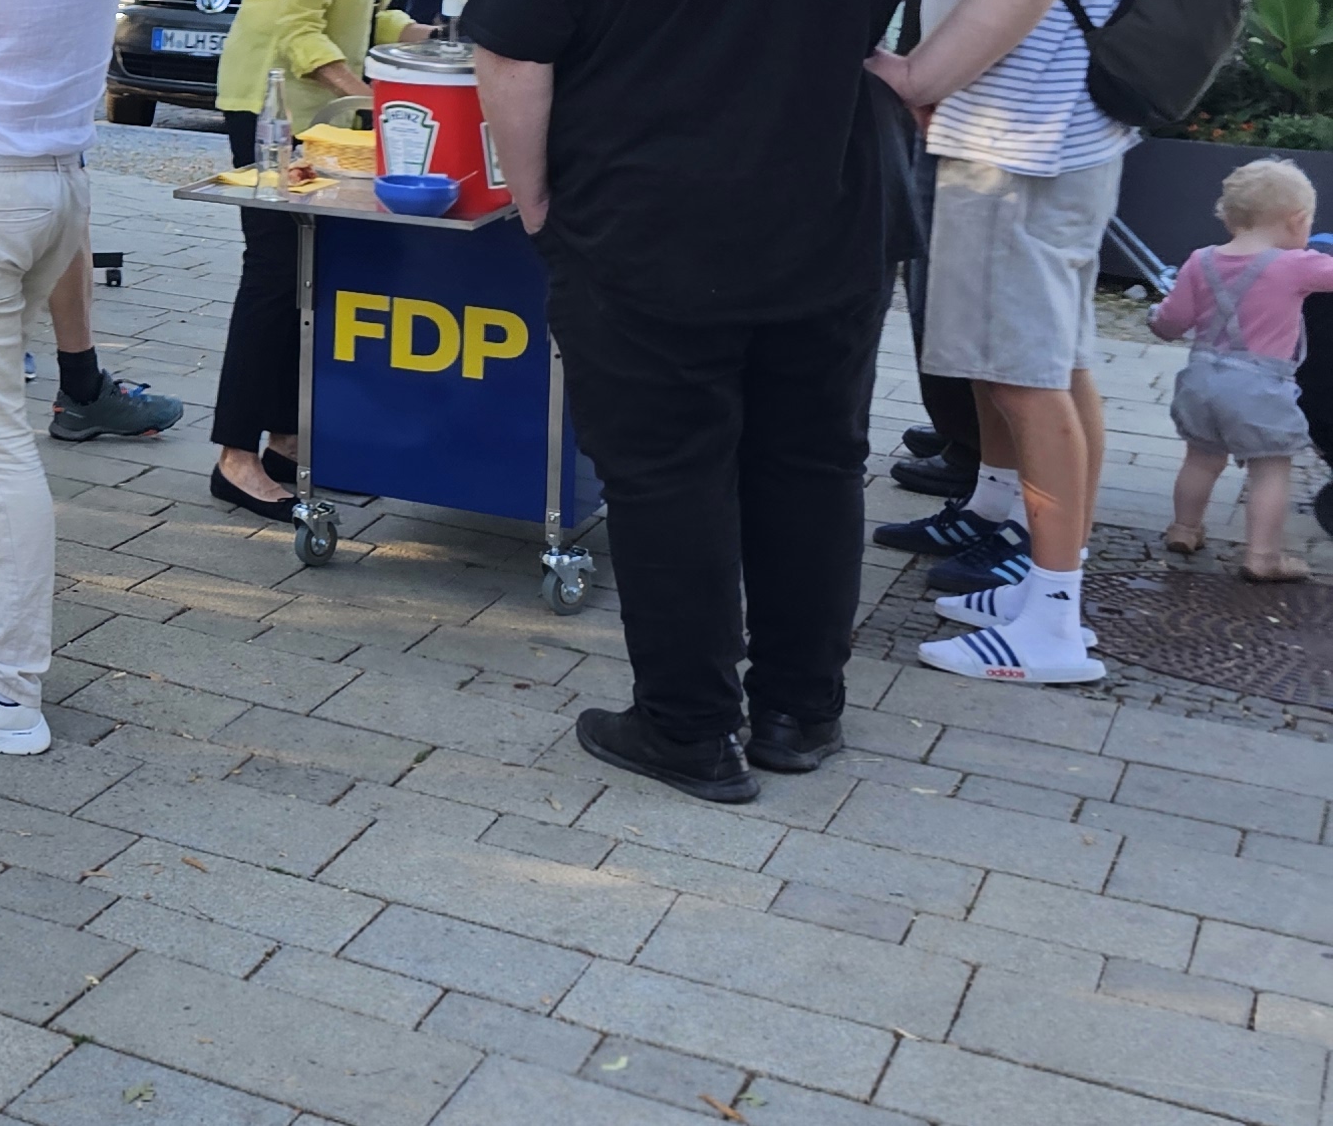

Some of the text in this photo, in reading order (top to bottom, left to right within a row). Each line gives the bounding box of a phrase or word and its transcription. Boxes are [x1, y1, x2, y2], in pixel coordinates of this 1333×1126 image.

[163, 32, 175, 48] M
[391, 110, 420, 123] HEINZ
[334, 290, 529, 380] FDP
[986, 668, 1025, 678] adidas
